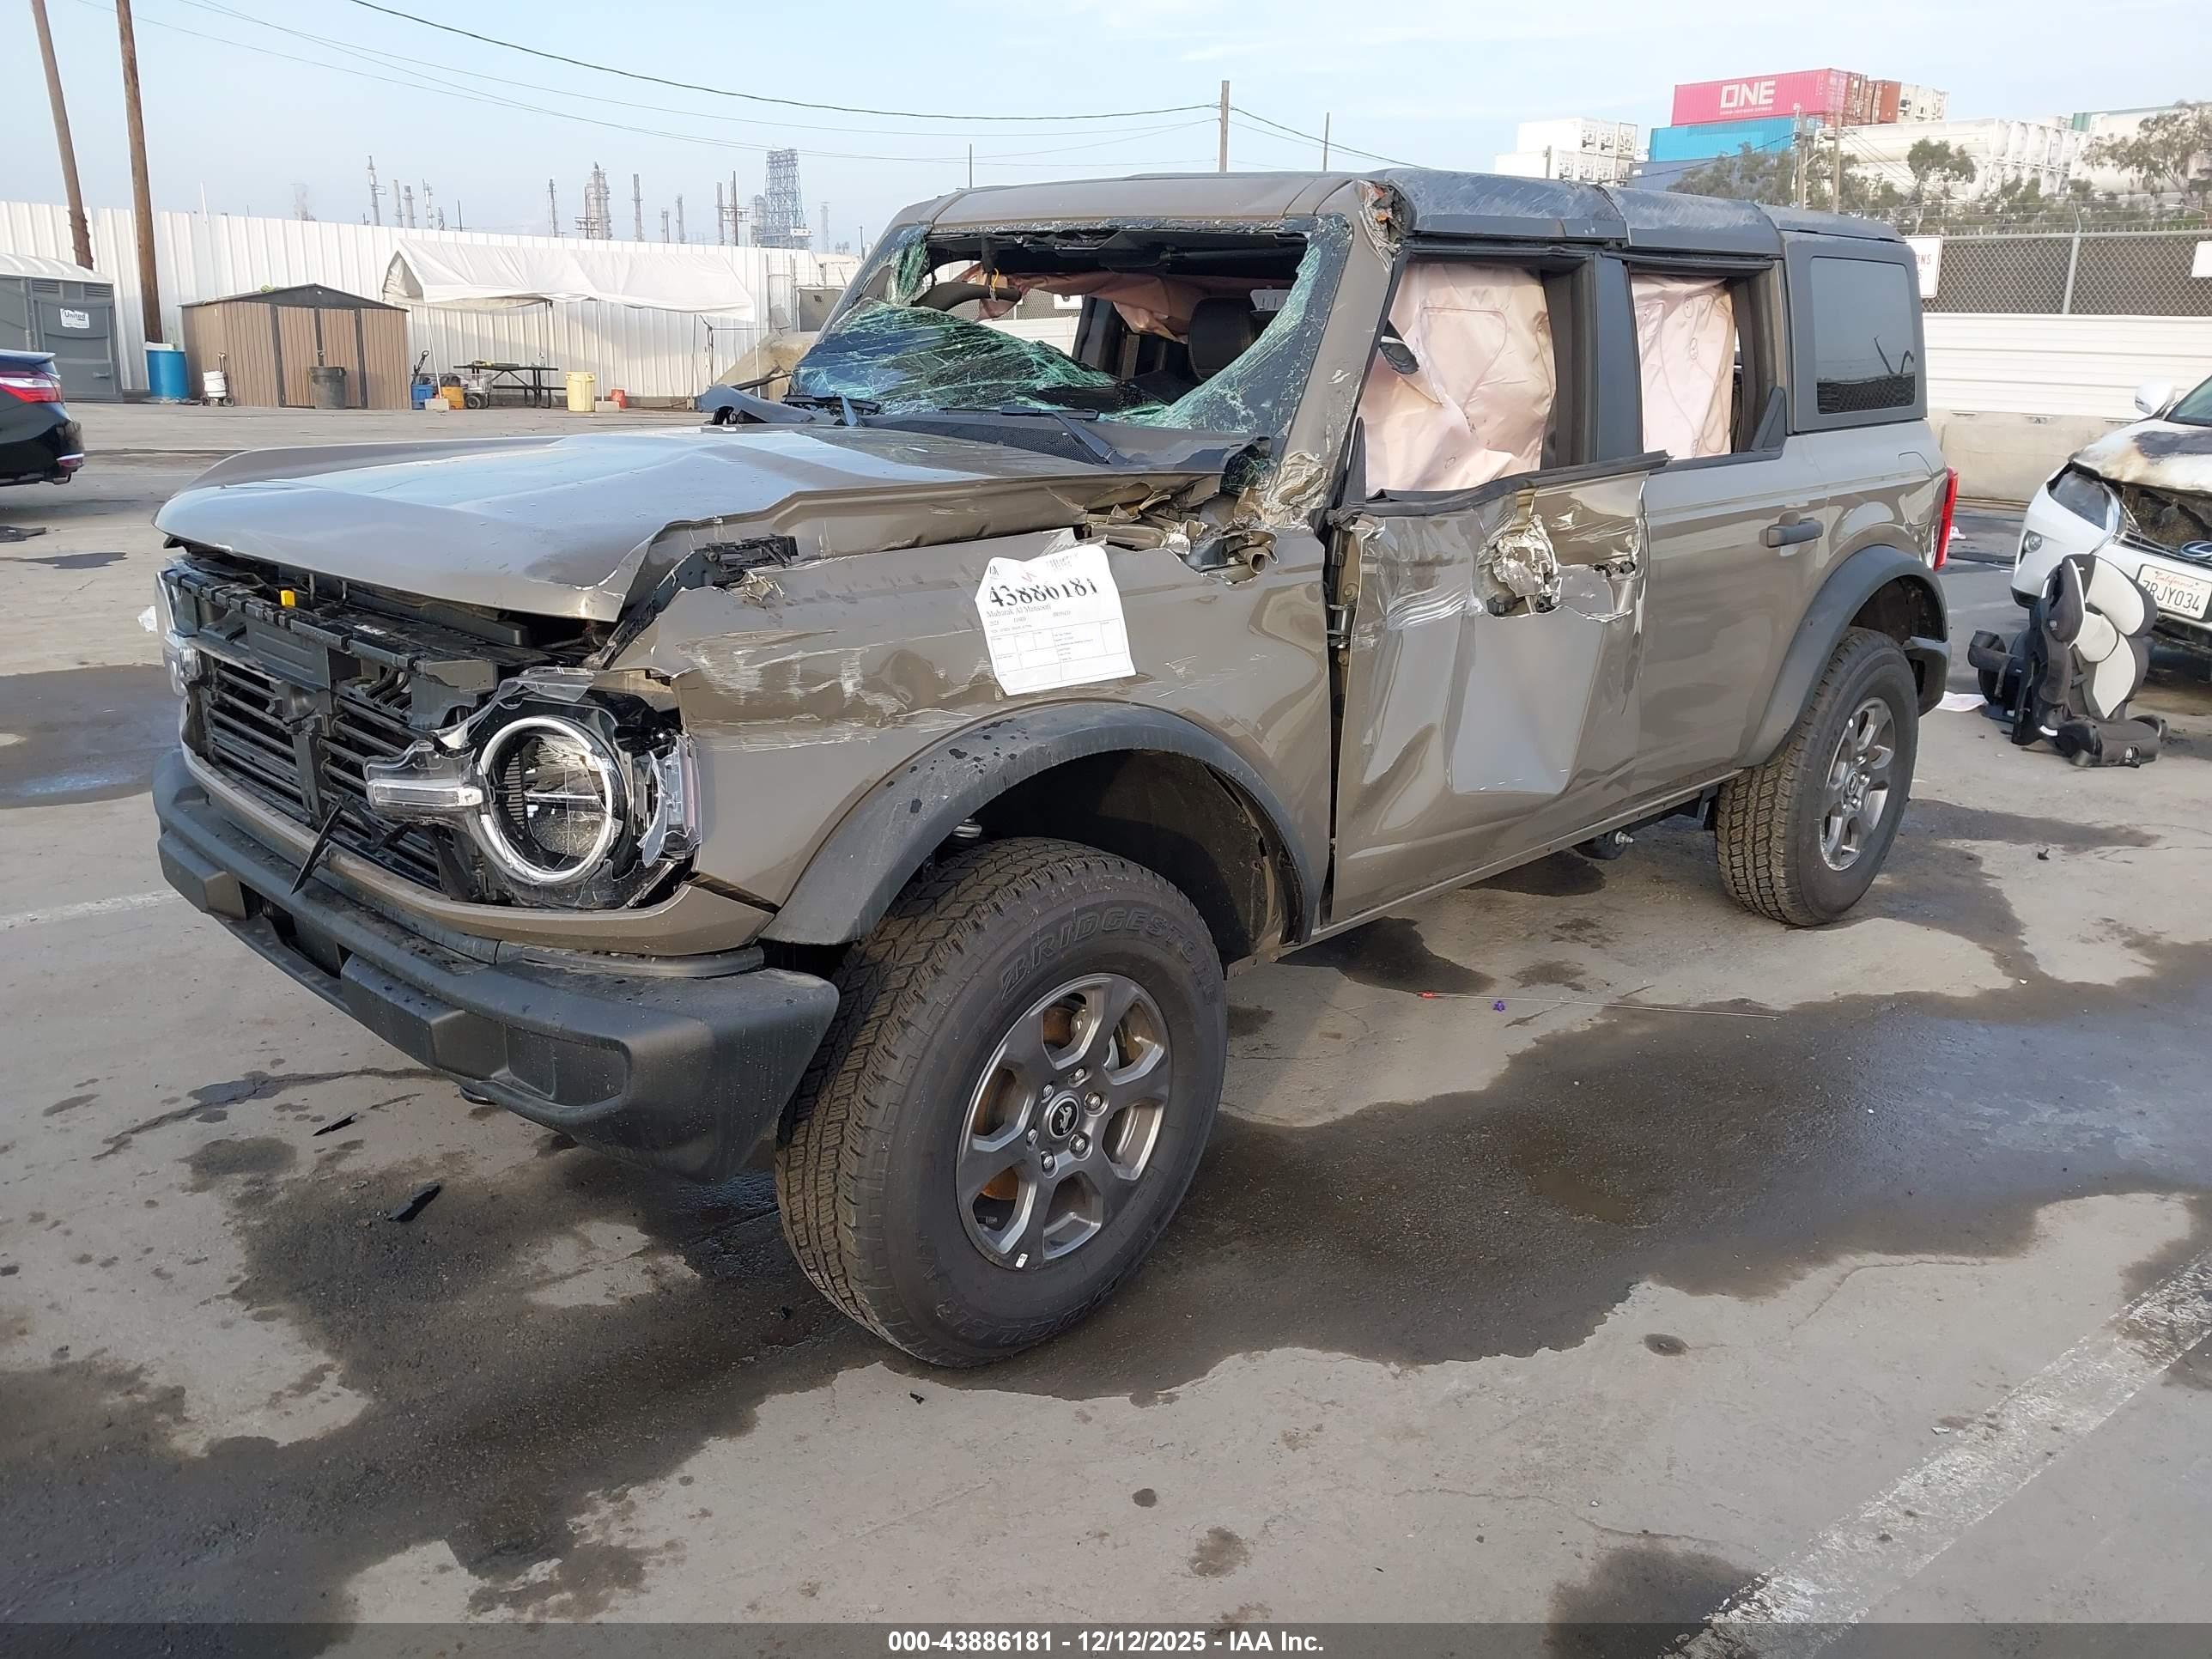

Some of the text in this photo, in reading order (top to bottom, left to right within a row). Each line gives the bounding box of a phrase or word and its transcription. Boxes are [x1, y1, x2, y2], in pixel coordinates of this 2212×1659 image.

[1720, 80, 1776, 108] ONE
[2143, 580, 2200, 611] 7RJY034
[1000, 907, 1218, 1003] BRIDGESTONE
